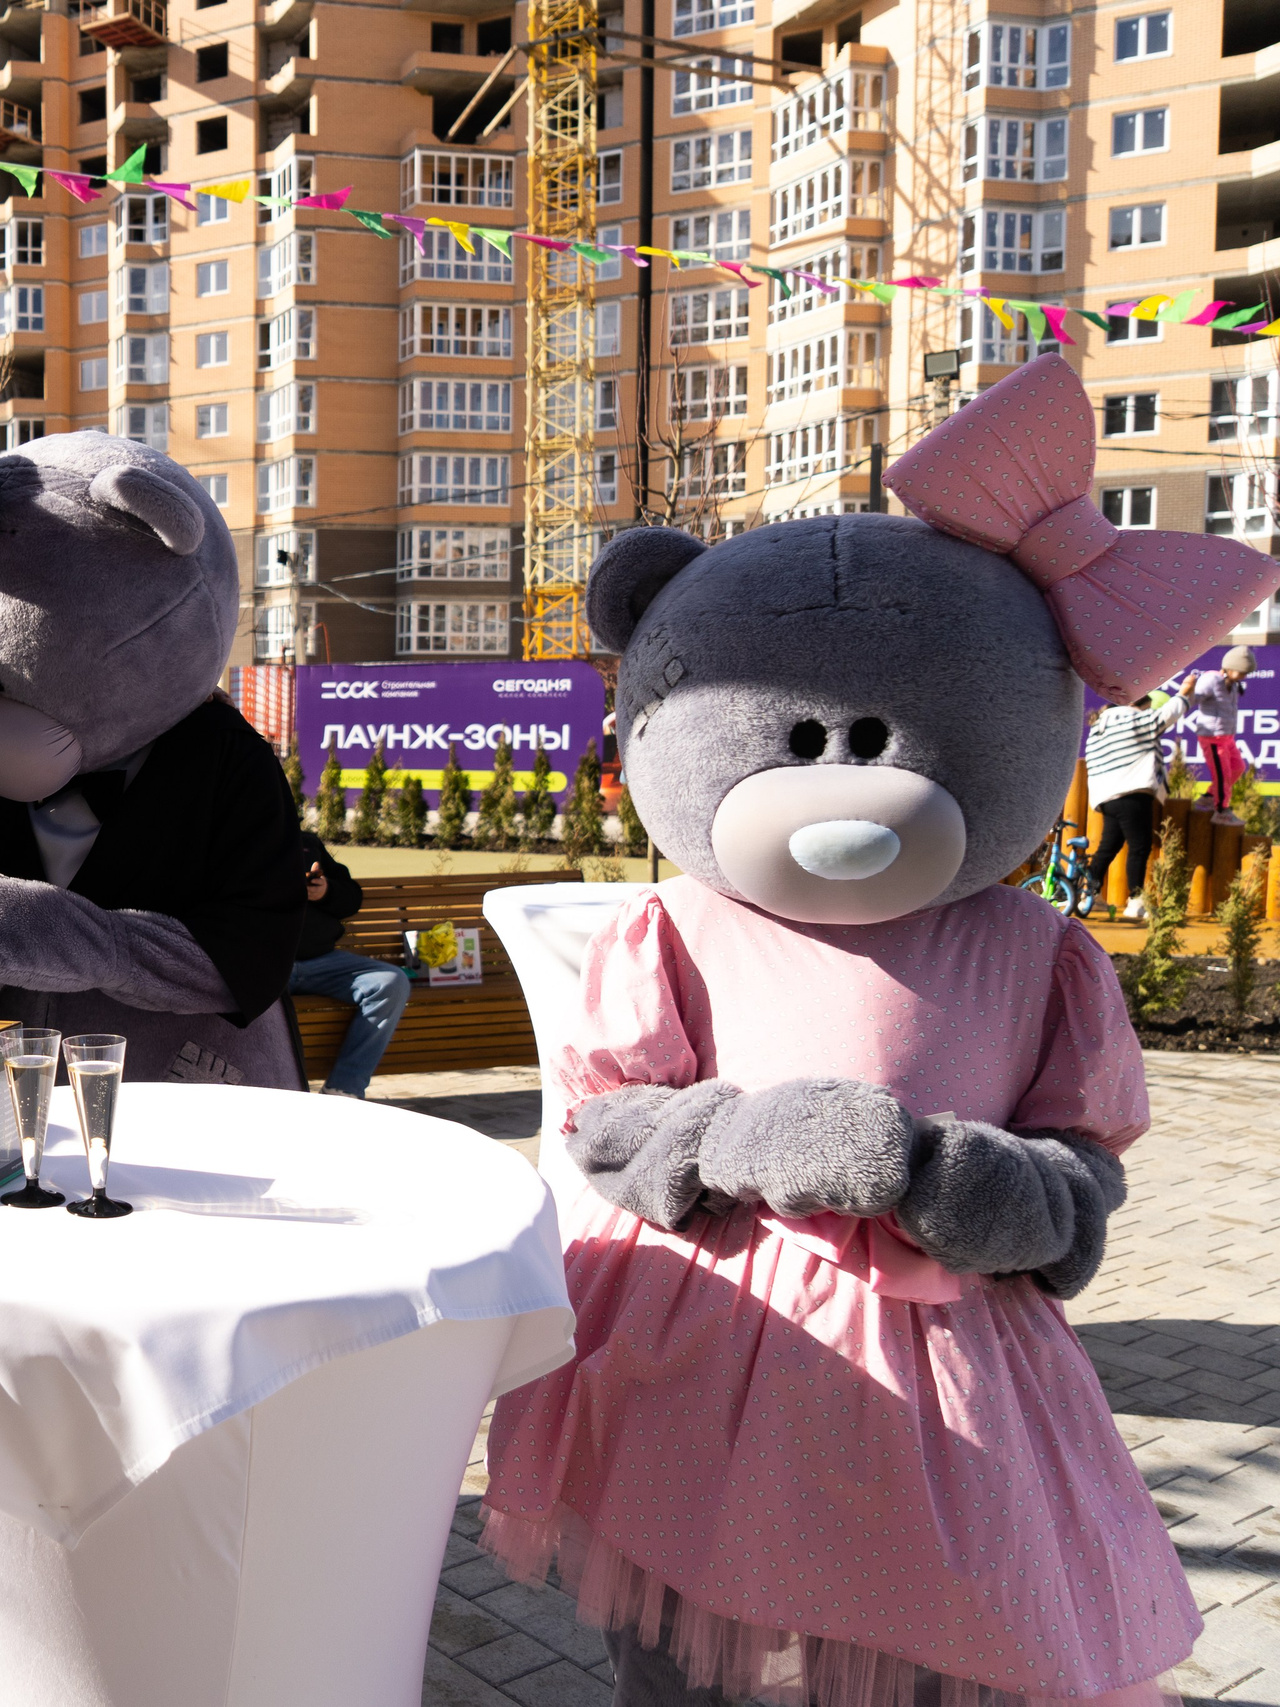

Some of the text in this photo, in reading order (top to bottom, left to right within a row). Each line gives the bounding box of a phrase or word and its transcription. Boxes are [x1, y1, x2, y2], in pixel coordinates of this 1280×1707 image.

[381, 680, 437, 690] Строительная
[492, 678, 572, 693] СЕГОДНЯ
[381, 690, 419, 698] компания
[320, 723, 570, 750] ЛАУНЖ-ЗОНЫ
